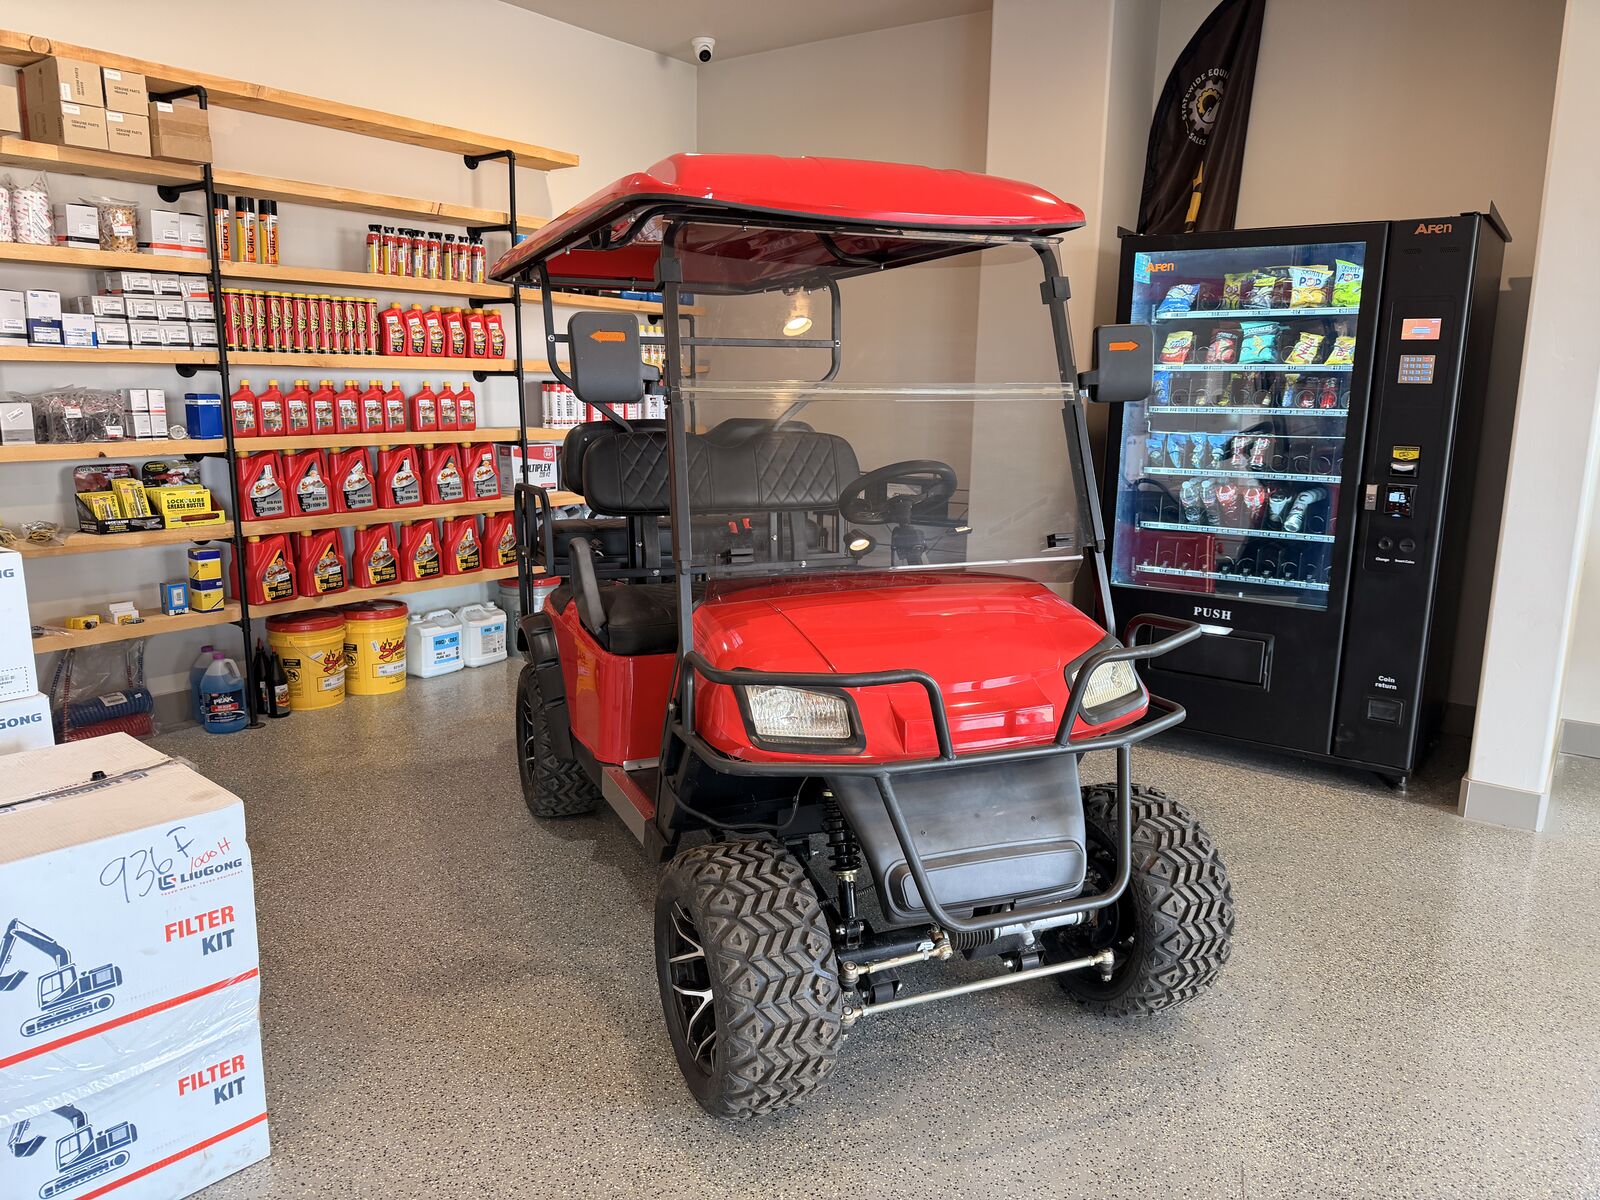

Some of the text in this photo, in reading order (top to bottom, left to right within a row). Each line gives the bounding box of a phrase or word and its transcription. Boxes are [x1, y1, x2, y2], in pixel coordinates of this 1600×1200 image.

[1182, 74, 1206, 120] STATEWIDE
[1189, 132, 1206, 146] SALES
[520, 463, 552, 474] MLTIPLEX
[1193, 606, 1232, 620] PUSH
[214, 695, 234, 704] PEAK
[217, 836, 232, 855] H
[100, 846, 173, 903] 936
[164, 905, 234, 942] FILTER
[202, 928, 234, 956] KIT
[178, 1054, 246, 1096] FILTER
[214, 1076, 246, 1105] KIT
